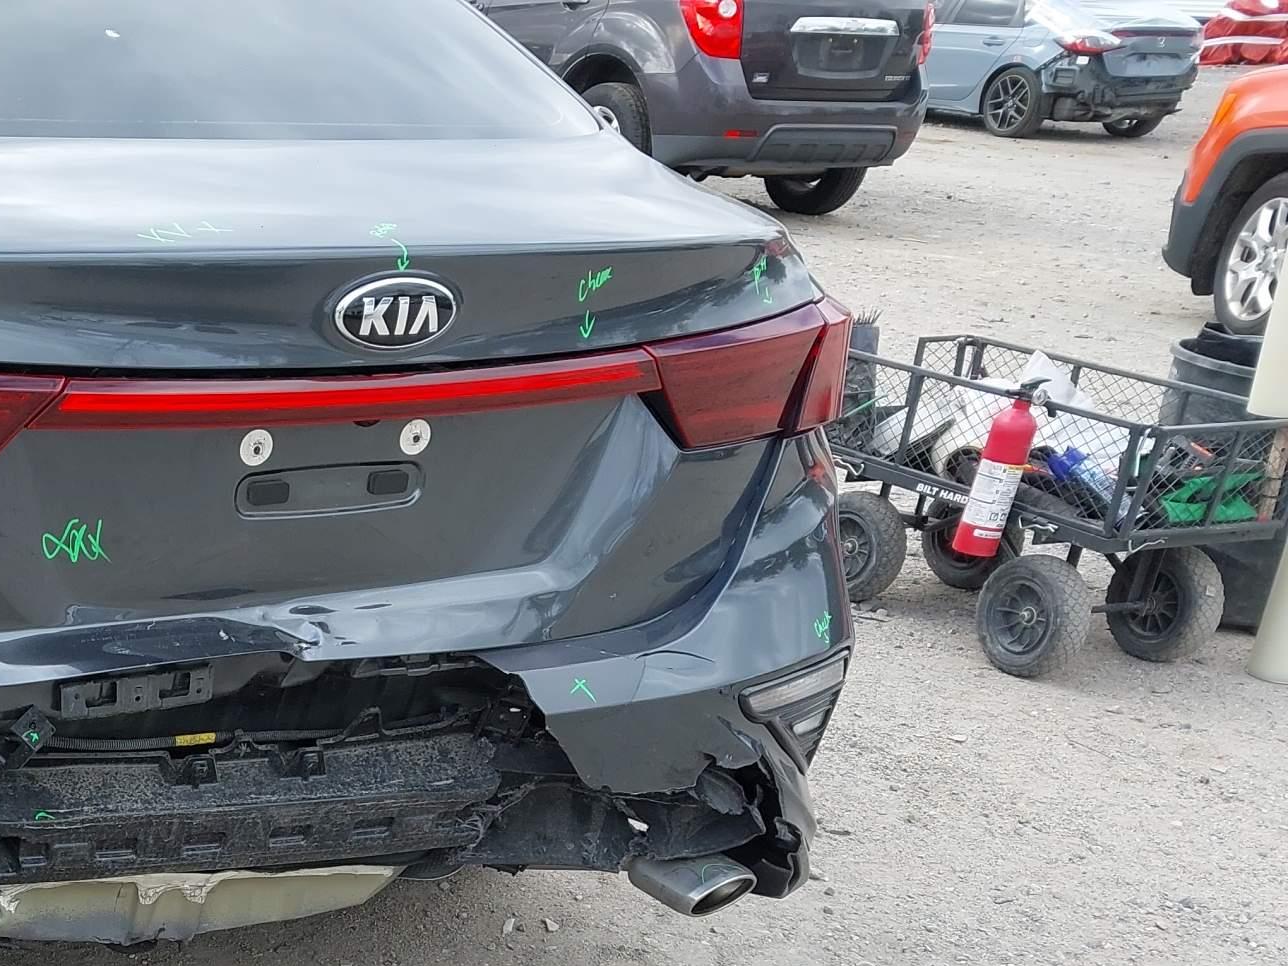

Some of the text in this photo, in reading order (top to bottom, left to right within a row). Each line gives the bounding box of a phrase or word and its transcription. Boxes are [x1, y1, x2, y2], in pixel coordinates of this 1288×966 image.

[359, 295, 439, 337] KIA
[915, 482, 970, 505] BILT HARD
